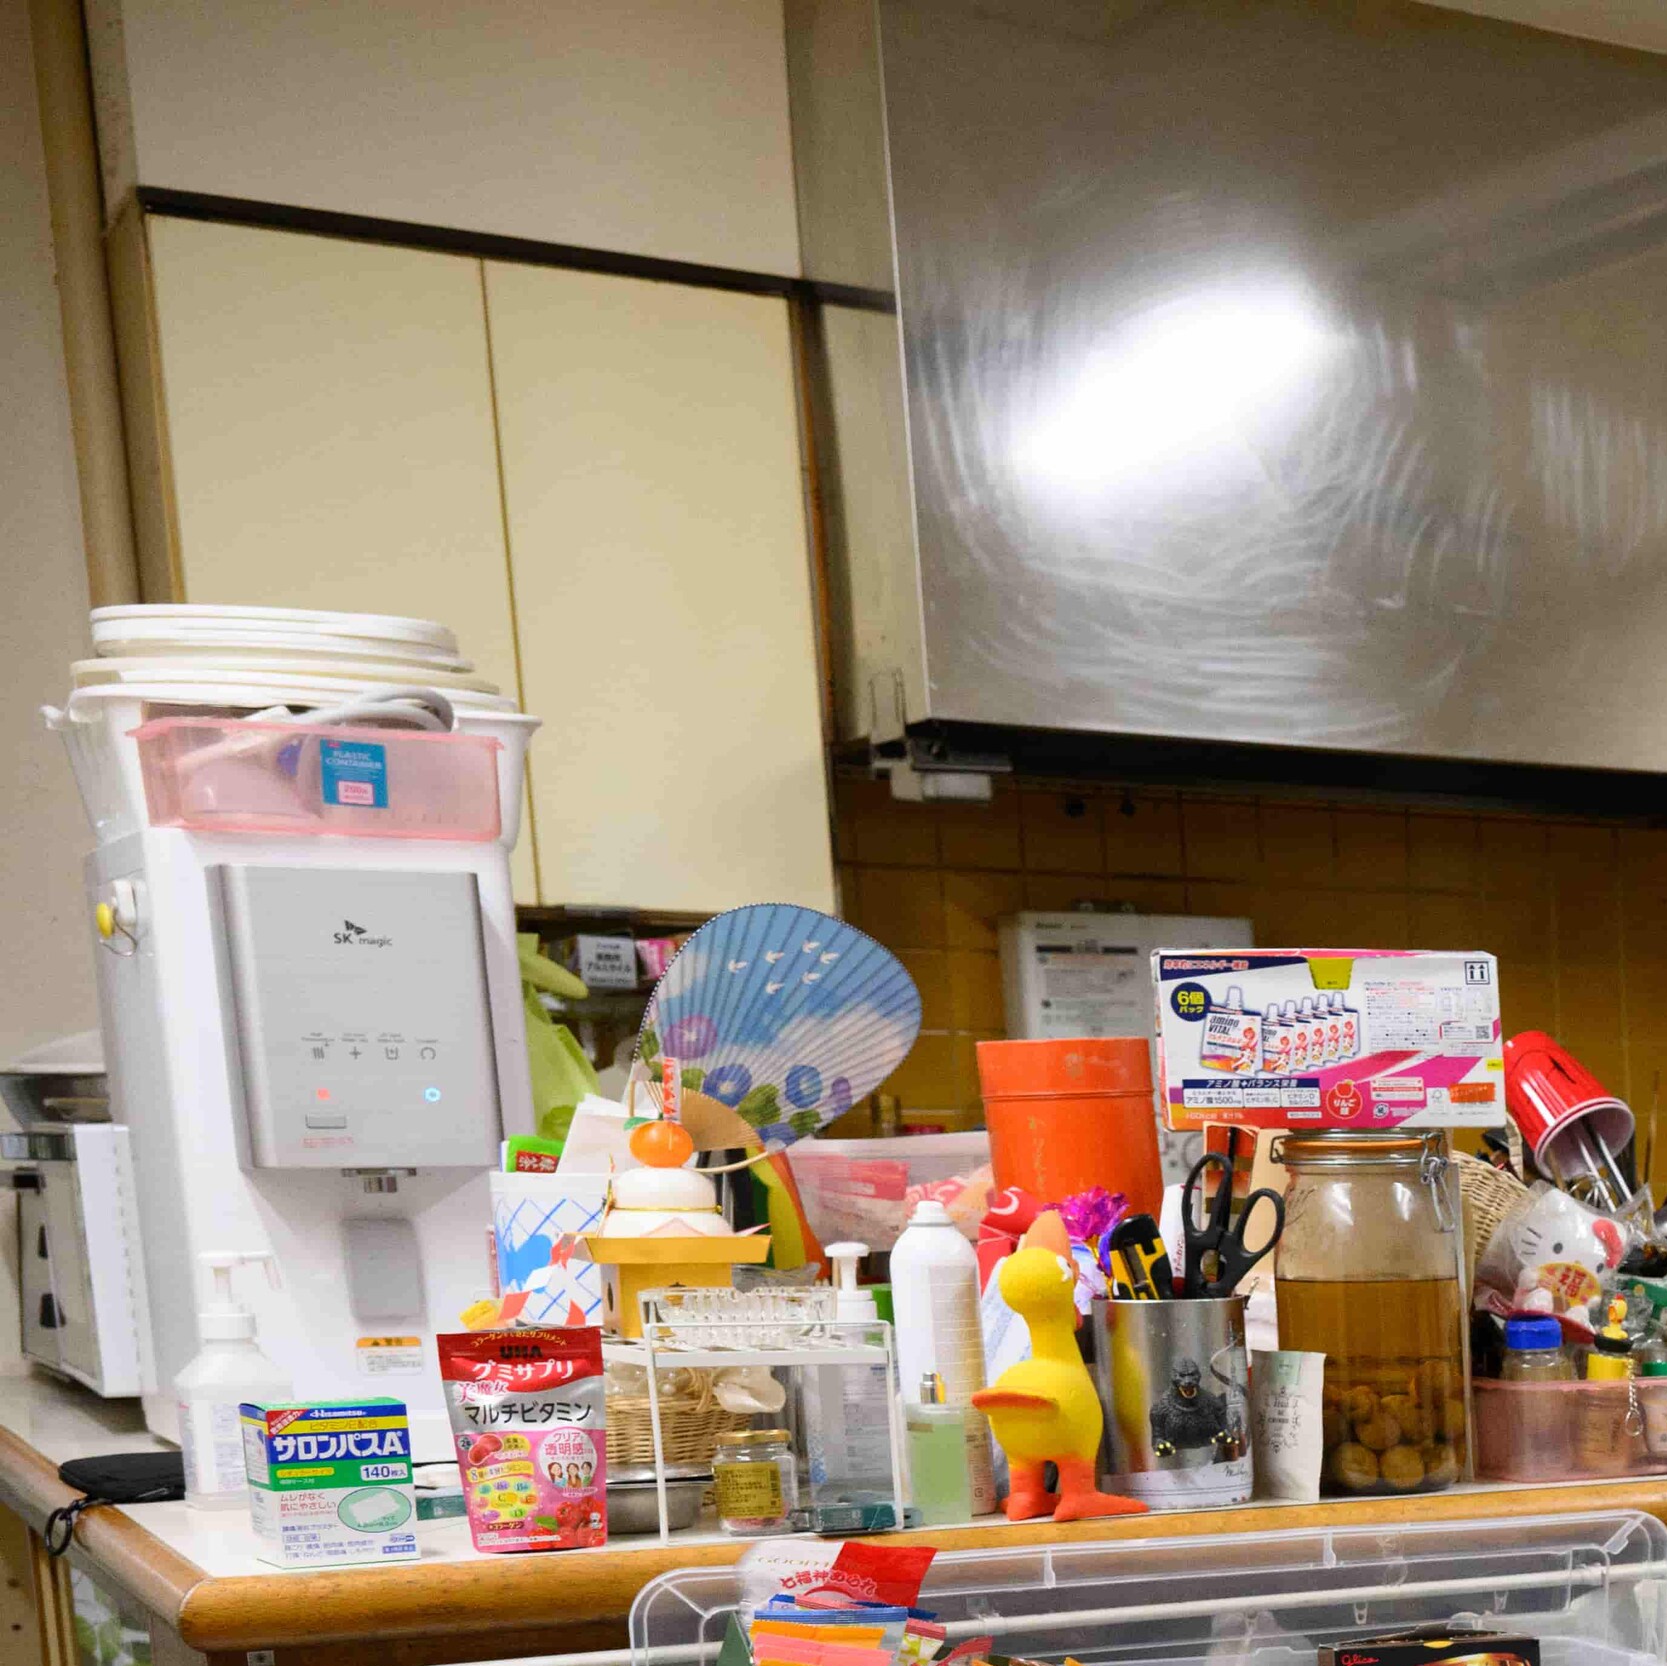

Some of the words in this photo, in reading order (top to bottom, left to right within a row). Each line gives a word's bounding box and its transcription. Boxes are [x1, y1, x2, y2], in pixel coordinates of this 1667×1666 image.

[333, 932, 353, 944] SK
[358, 936, 393, 948] magic
[1176, 991, 1205, 1006] 6個
[1209, 1015, 1240, 1028] amino
[1207, 1024, 1232, 1036] VITAL
[500, 1346, 544, 1360] UHA
[472, 1358, 574, 1381] グミサプリ
[464, 1402, 592, 1426] マルチビタミン
[272, 1430, 406, 1462] サロンパスA
